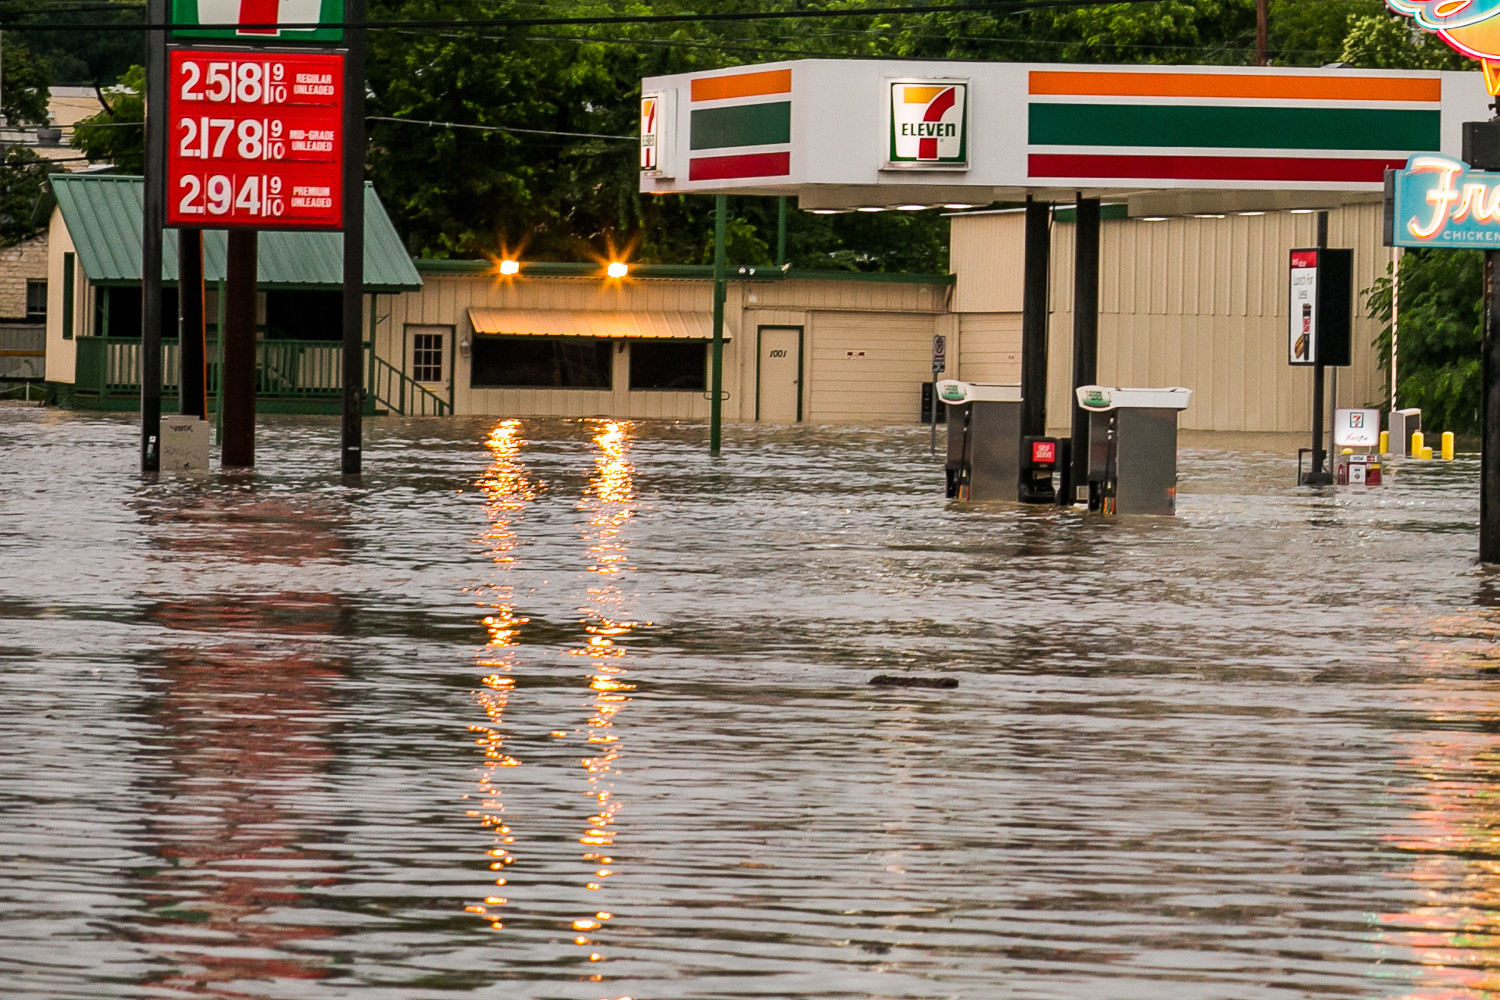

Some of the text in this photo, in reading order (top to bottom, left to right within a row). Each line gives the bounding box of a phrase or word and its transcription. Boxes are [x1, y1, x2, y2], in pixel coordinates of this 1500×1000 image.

[181, 61, 262, 103] 2.58
[296, 73, 332, 84] REGULAR
[293, 84, 334, 95] UNLEADED
[289, 130, 334, 140] MID-GRADE
[292, 141, 332, 151] UNLEADED
[179, 174, 261, 215] 2.94
[293, 186, 330, 196] PREMIUM
[291, 197, 332, 207] UNLEADED
[769, 349, 787, 358] 1001
